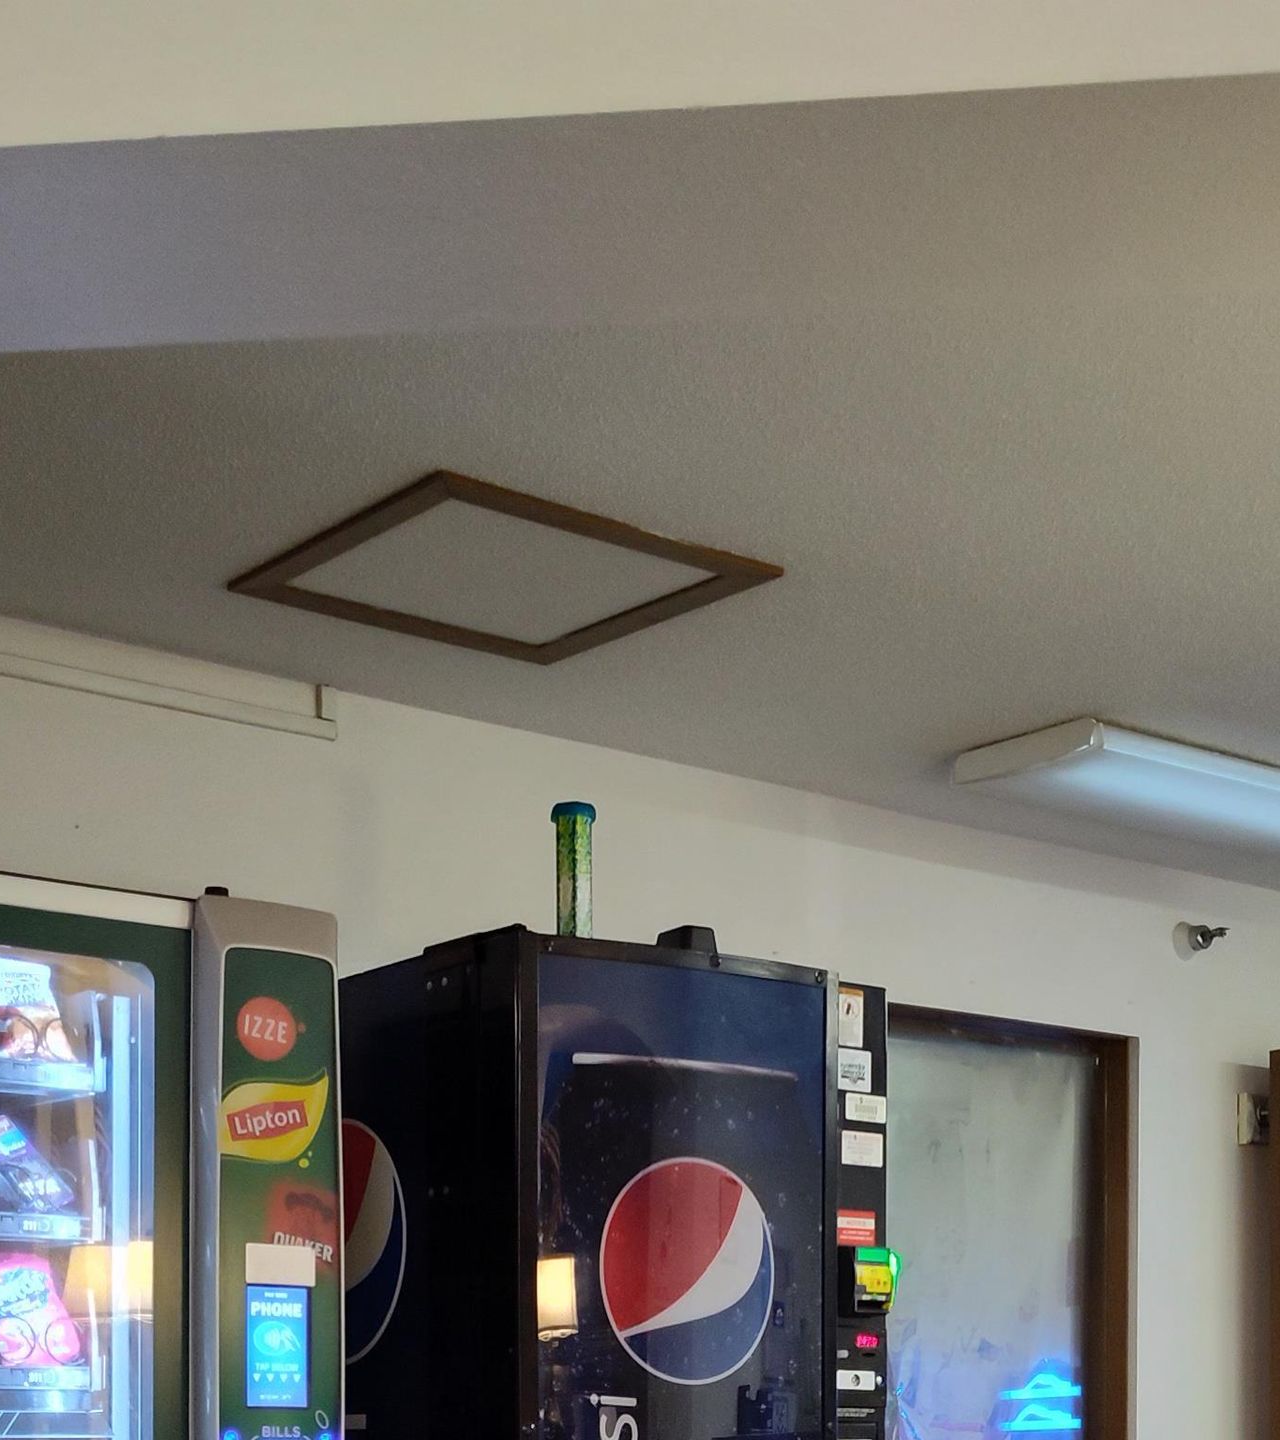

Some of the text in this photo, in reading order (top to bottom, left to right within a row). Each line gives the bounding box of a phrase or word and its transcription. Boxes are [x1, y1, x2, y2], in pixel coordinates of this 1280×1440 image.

[242, 1013, 288, 1044] IZZE
[233, 1106, 302, 1137] Lipton
[251, 1301, 302, 1318] PHONE
[261, 1425, 302, 1439] BILLS
